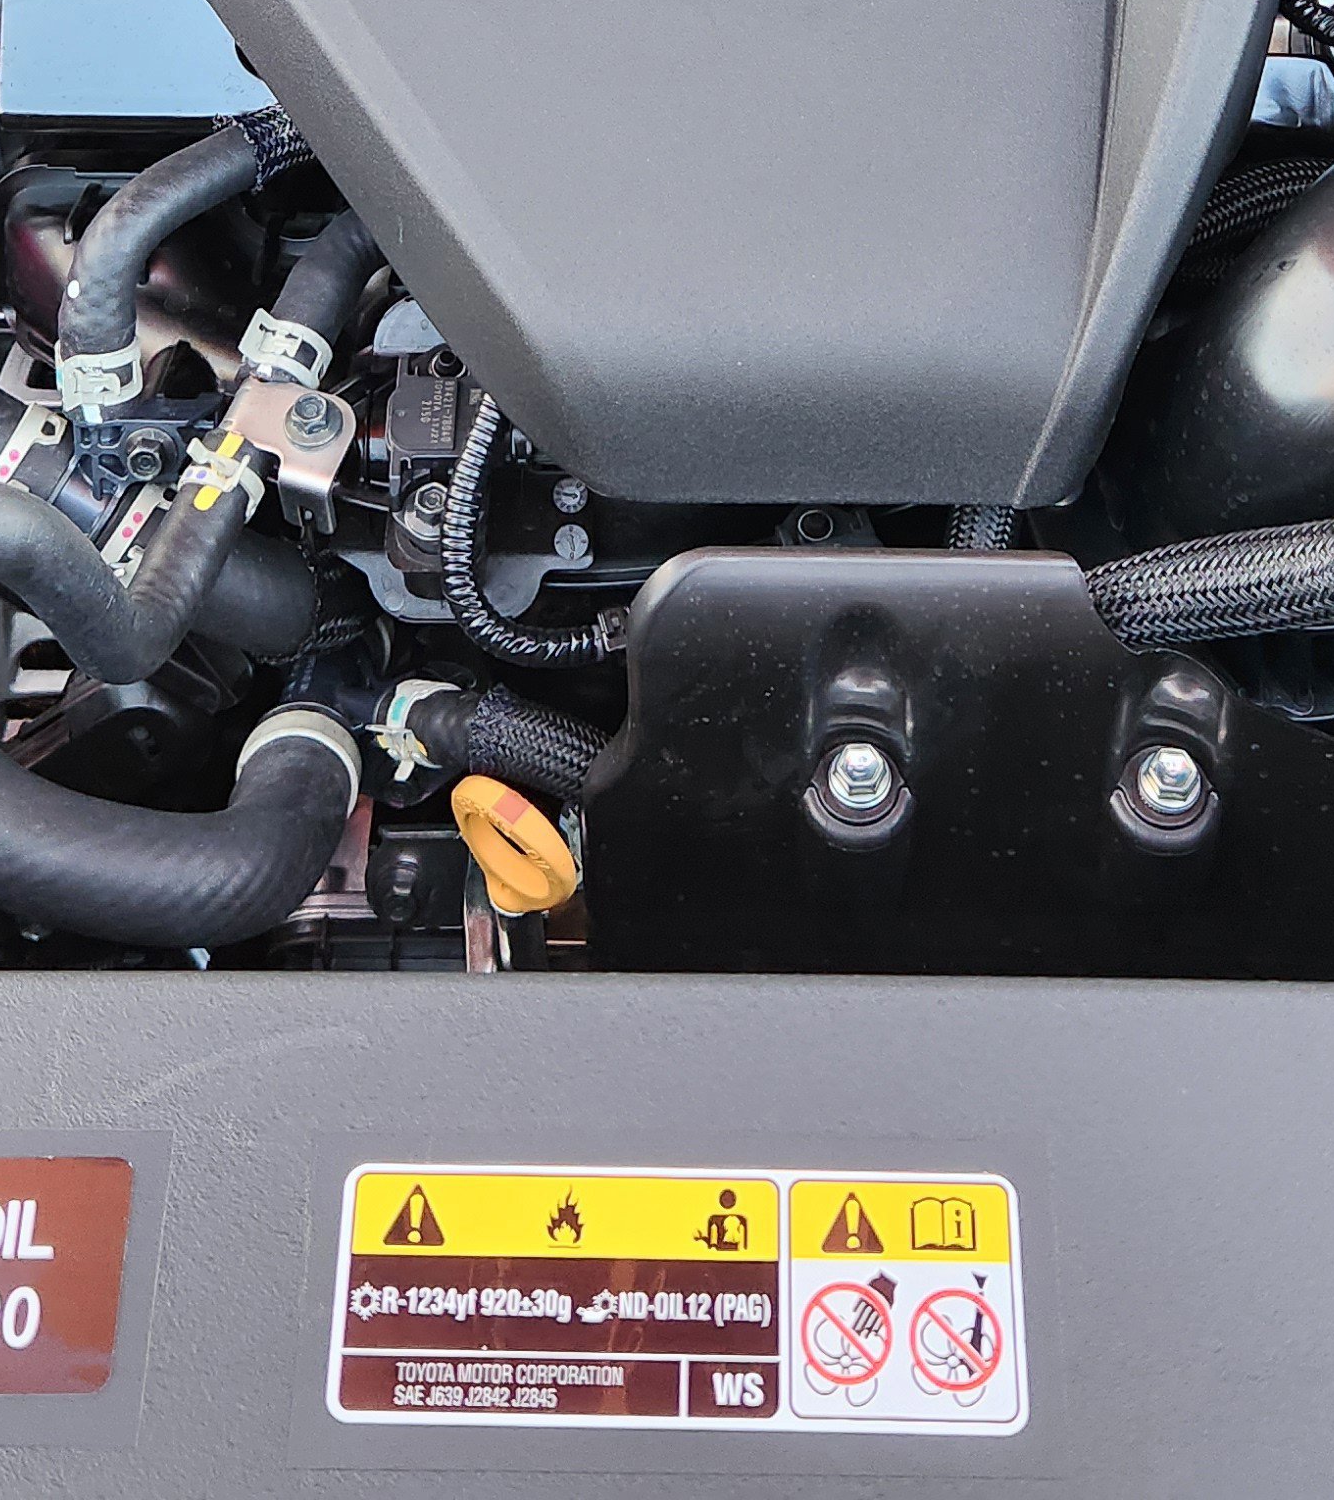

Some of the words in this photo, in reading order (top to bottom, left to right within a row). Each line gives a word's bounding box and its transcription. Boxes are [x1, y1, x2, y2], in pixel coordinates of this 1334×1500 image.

[433, 380, 444, 412] TOYOTA
[381, 1286, 476, 1322] R-1234yf
[480, 1288, 572, 1325] 920±30g
[617, 1291, 711, 1322] ND-OIL12
[713, 1292, 773, 1328] (PAG)
[395, 1361, 455, 1384] TOYOTA
[456, 1362, 514, 1385] MOTOR
[515, 1364, 625, 1387] CORPORATION
[712, 1371, 766, 1407] WS
[393, 1386, 425, 1407] SAE
[425, 1386, 463, 1408] J639
[464, 1387, 511, 1409] J2842
[511, 1388, 559, 1409] J2845
